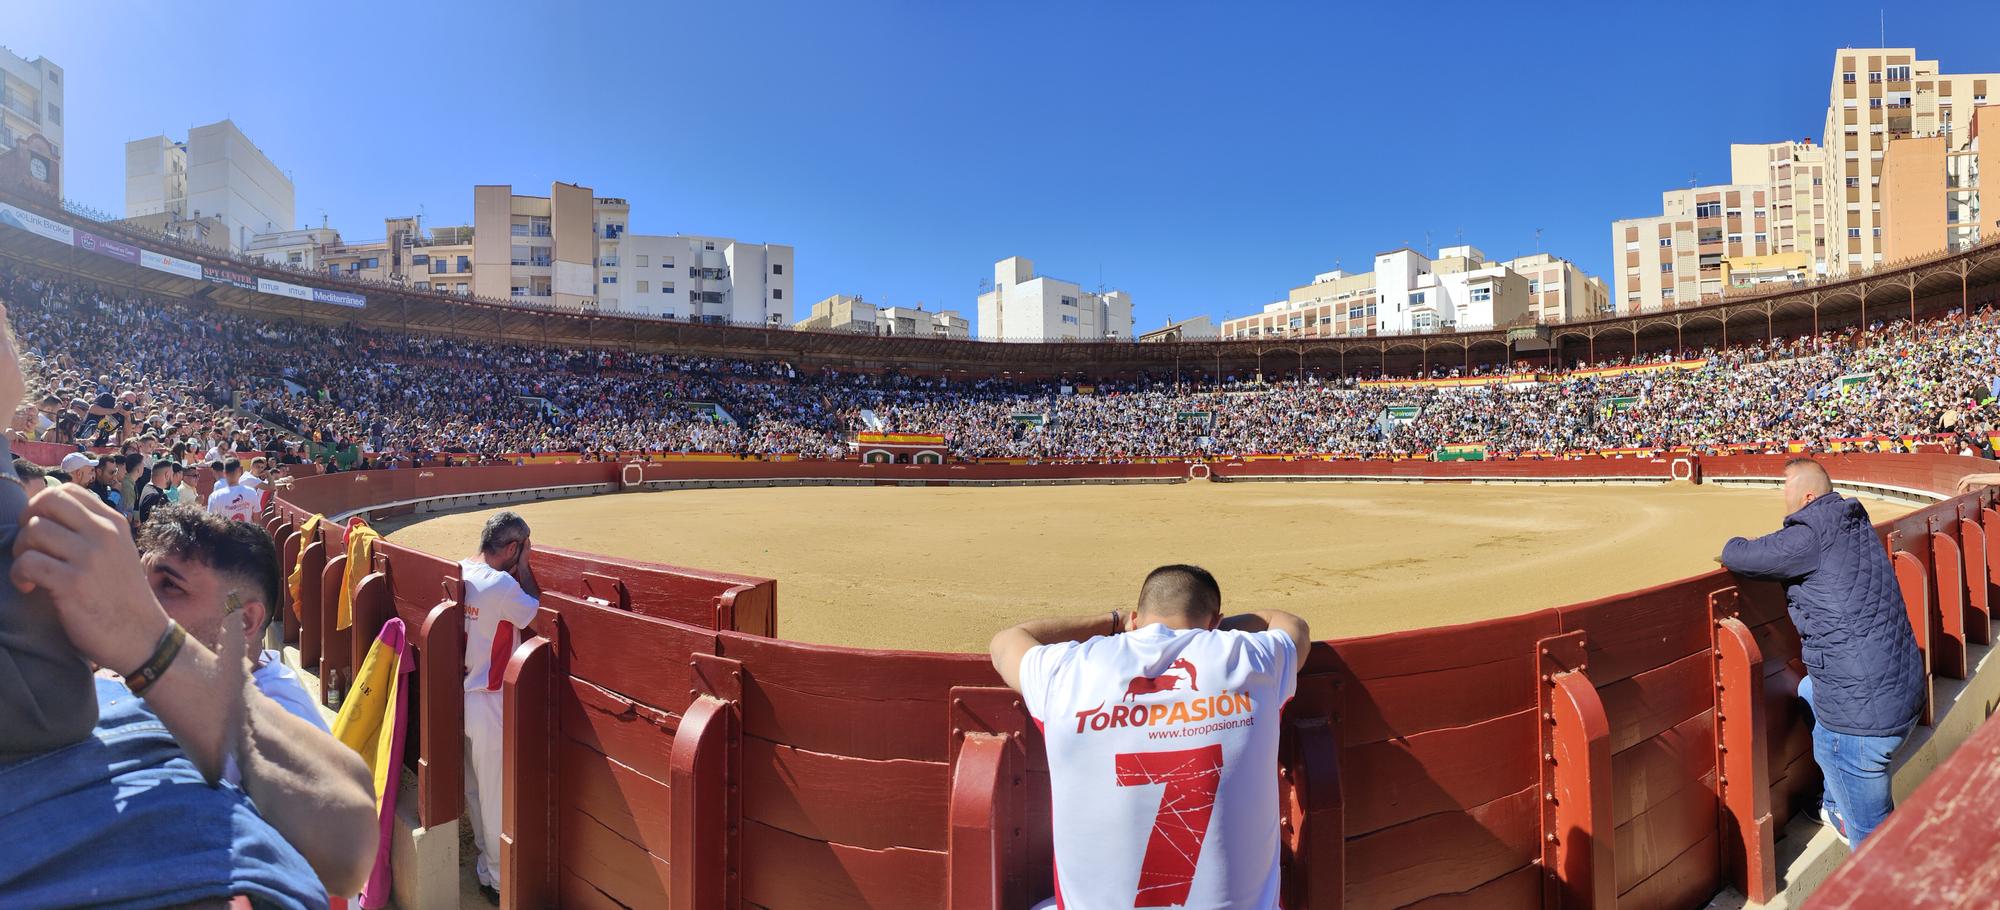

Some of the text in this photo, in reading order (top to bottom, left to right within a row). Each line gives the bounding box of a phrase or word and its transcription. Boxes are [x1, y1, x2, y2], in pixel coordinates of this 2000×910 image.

[43, 219, 71, 235] Broker
[204, 267, 219, 277] SPY
[221, 271, 252, 284] CENTER
[314, 291, 365, 307] Mediterráneo
[1148, 716, 1254, 740] www.toropasion.net
[1115, 743, 1223, 909] 7
